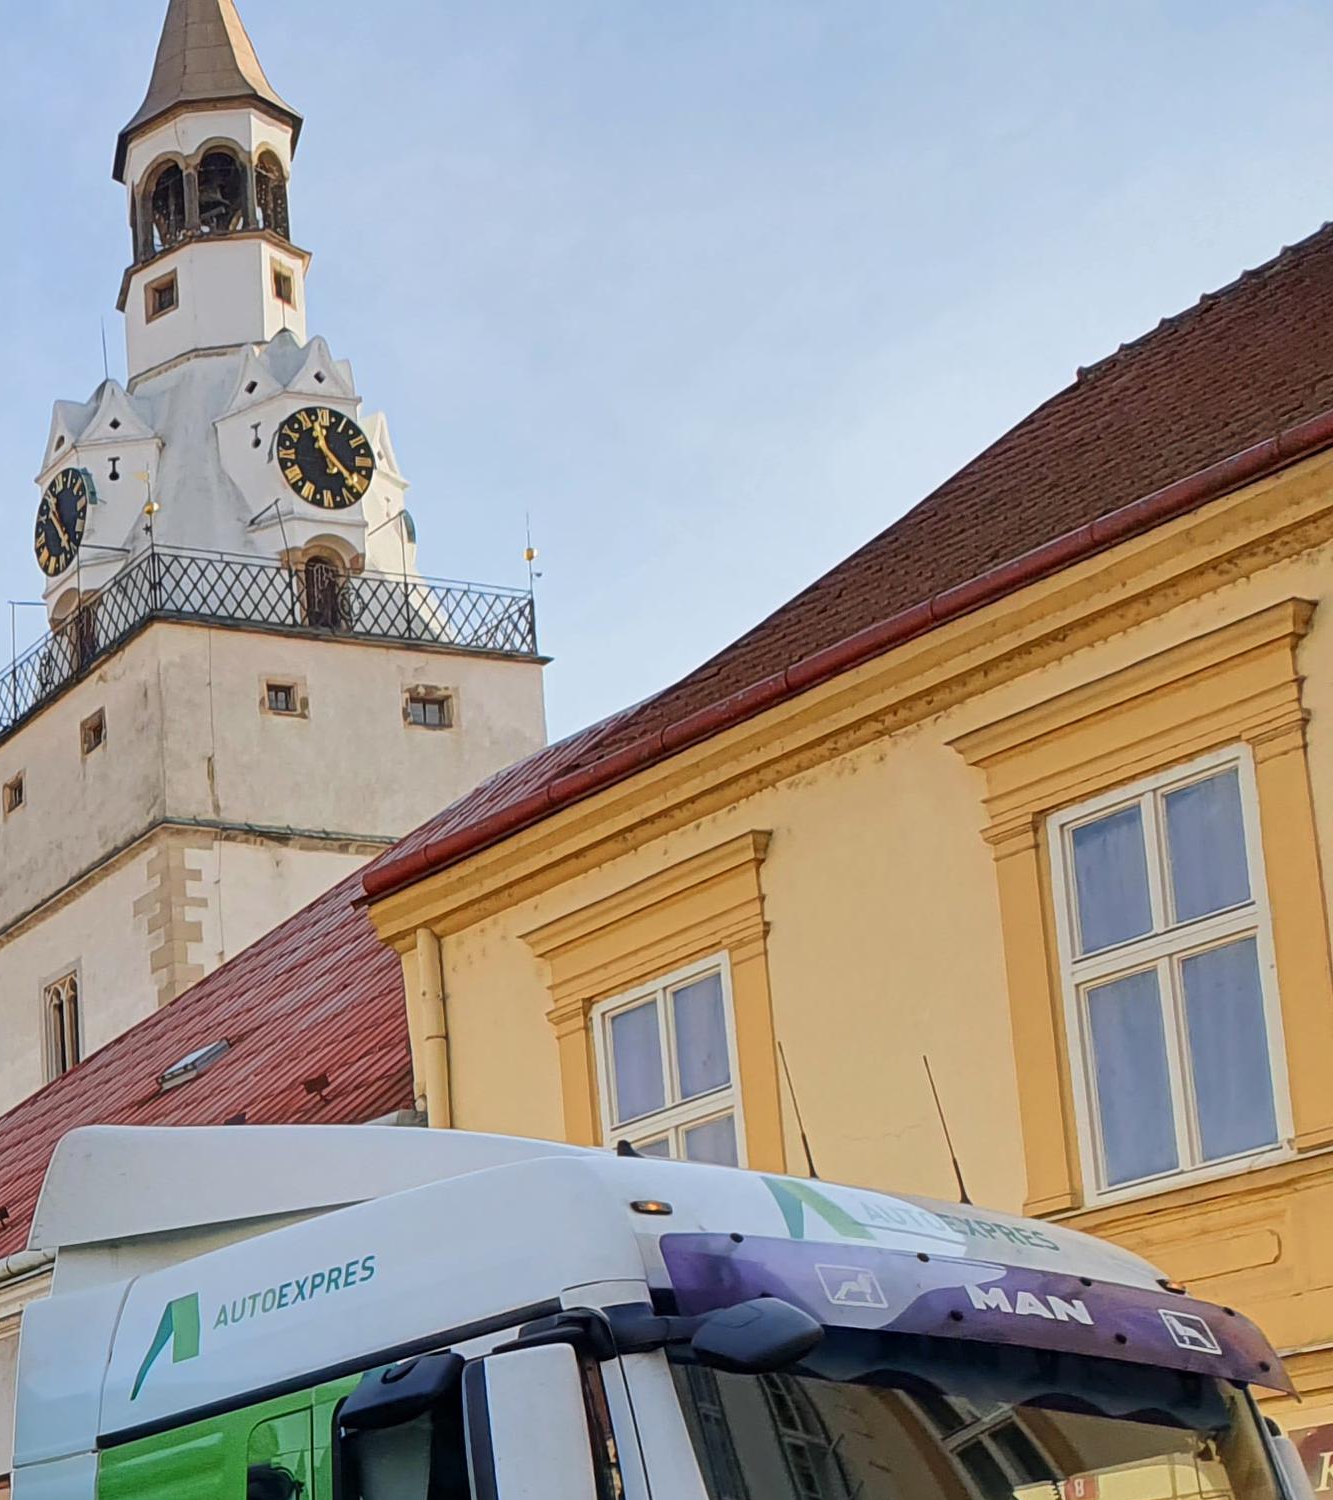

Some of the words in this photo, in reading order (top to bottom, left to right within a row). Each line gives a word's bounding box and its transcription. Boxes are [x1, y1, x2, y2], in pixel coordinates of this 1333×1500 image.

[861, 1202, 1060, 1252] AUTOEXPRES
[213, 1255, 376, 1329] AUTOEXPRES
[964, 1284, 1094, 1325] MAN
